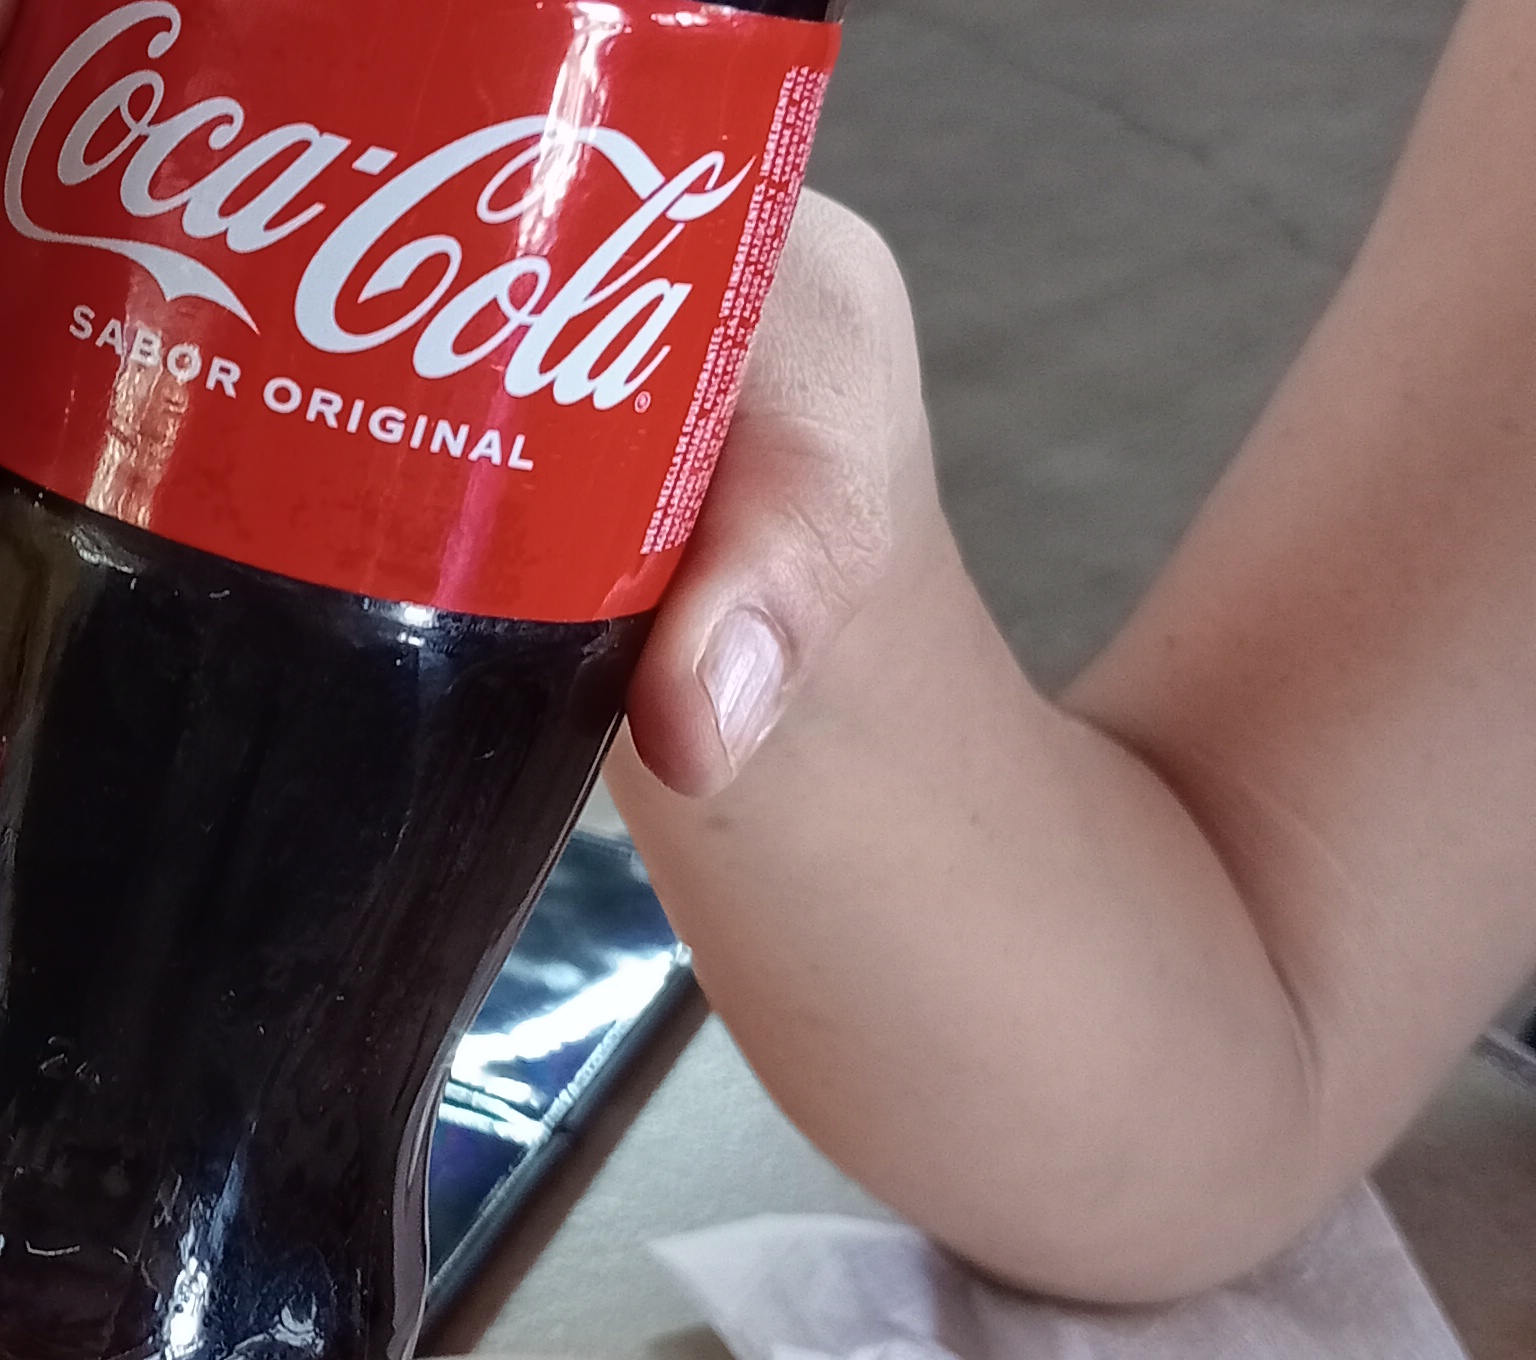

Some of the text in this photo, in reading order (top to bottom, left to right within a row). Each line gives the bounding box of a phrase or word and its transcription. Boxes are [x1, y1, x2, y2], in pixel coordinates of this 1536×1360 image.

[5, 0, 757, 413] Coca-Cola
[69, 304, 534, 471] SABOR ORIGINAL
